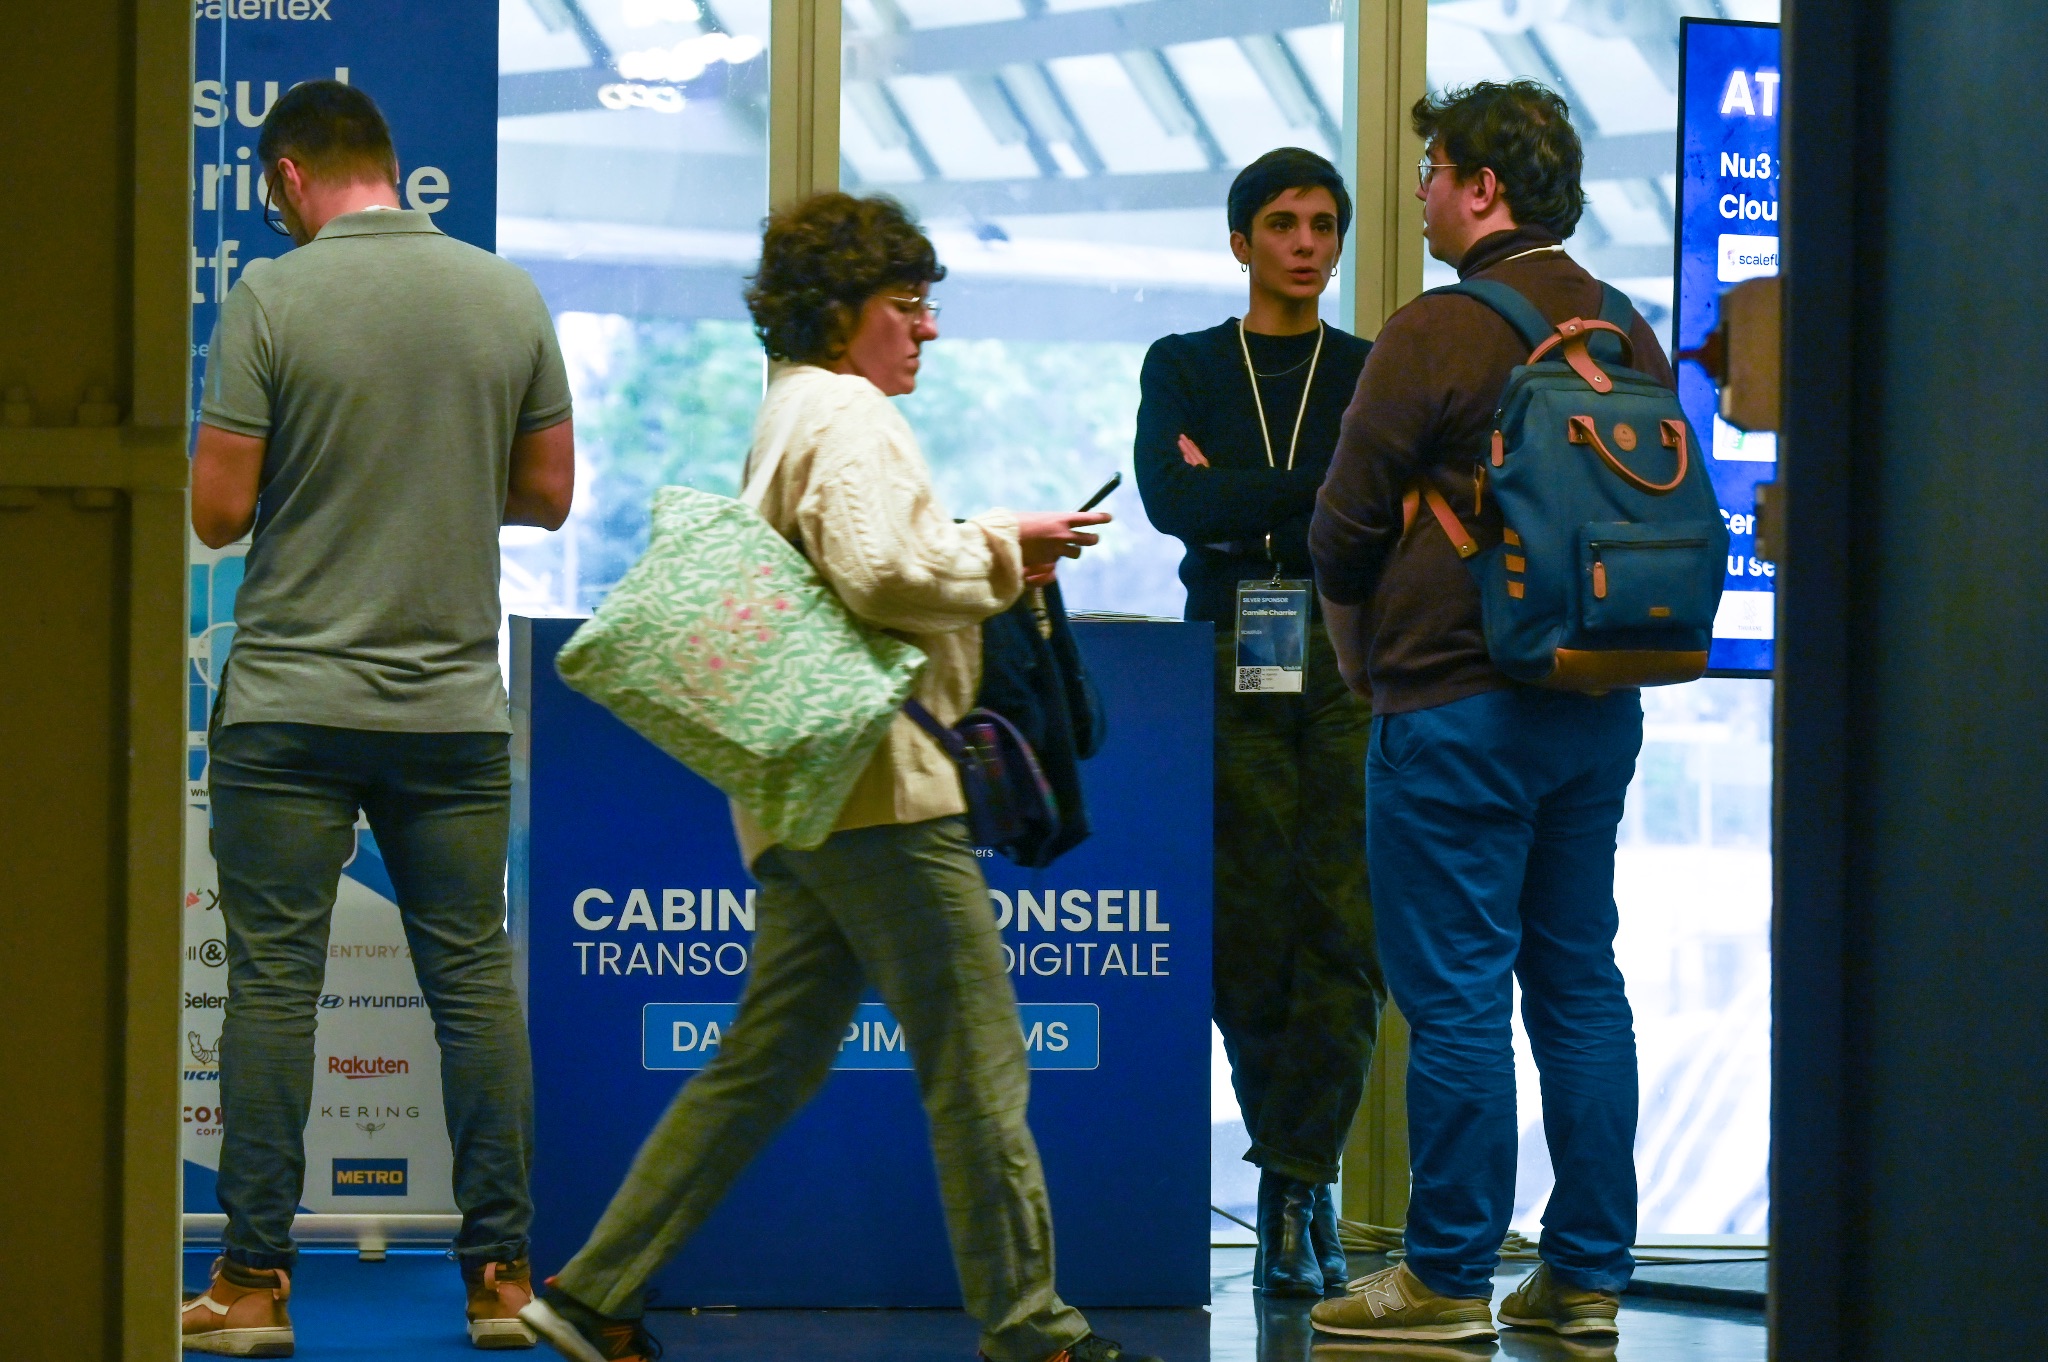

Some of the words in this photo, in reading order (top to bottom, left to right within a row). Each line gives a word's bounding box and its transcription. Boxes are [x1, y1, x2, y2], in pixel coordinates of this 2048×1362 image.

[1720, 152, 1771, 179] Nu3
[573, 888, 757, 931] CABIN
[349, 996, 424, 1008] HYUNDAI
[328, 1055, 409, 1074] Rakuten
[321, 1106, 419, 1118] KERING
[336, 1170, 404, 1184] METRO
